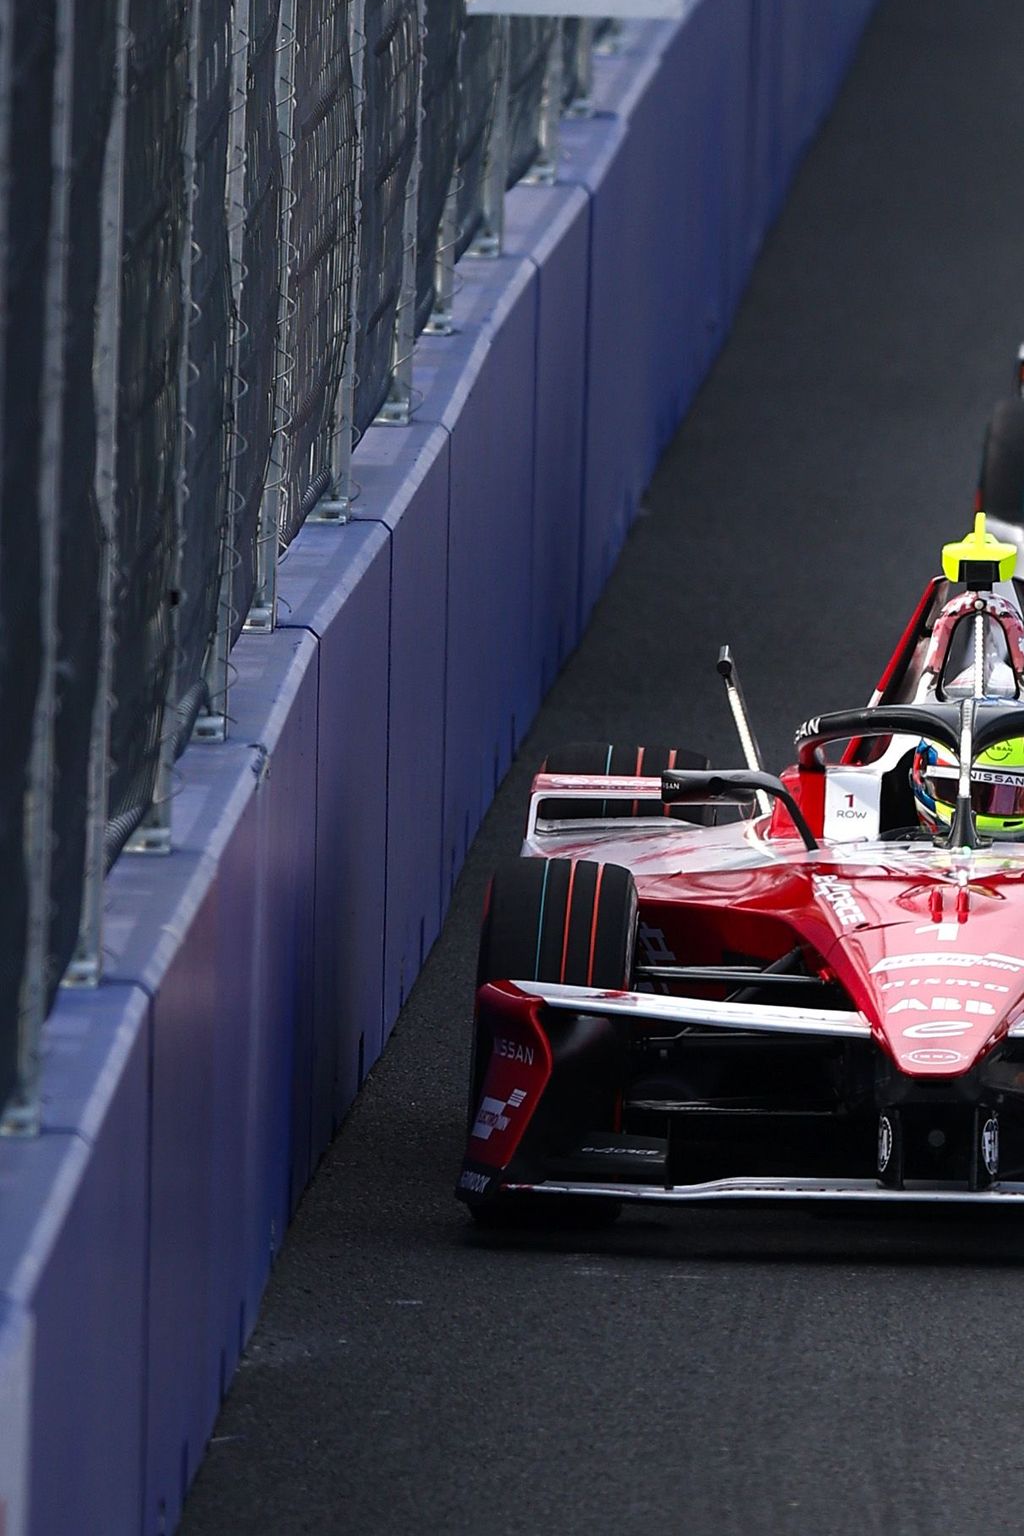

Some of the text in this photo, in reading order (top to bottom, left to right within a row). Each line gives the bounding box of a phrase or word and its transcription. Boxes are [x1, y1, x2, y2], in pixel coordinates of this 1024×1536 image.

[844, 793, 854, 808] 1
[836, 810, 867, 819] ROW
[914, 923, 960, 941] 1
[887, 997, 996, 1016] ABB
